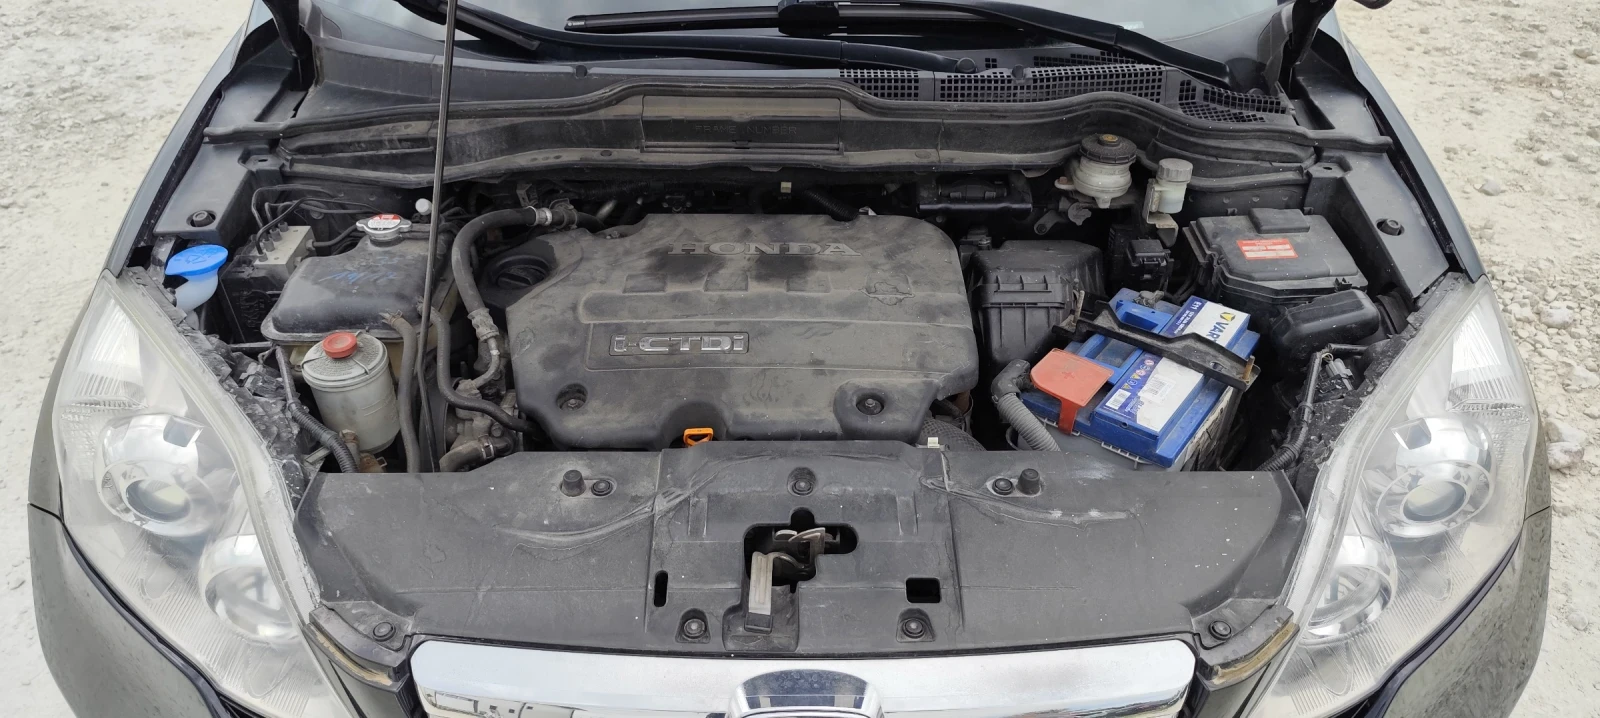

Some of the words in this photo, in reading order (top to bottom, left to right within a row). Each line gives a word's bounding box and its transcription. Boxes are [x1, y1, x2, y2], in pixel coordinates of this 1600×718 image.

[695, 125, 737, 134] FRAME
[745, 125, 797, 135] NUMBER
[667, 241, 862, 257] HONDA
[1206, 321, 1229, 343] VAR
